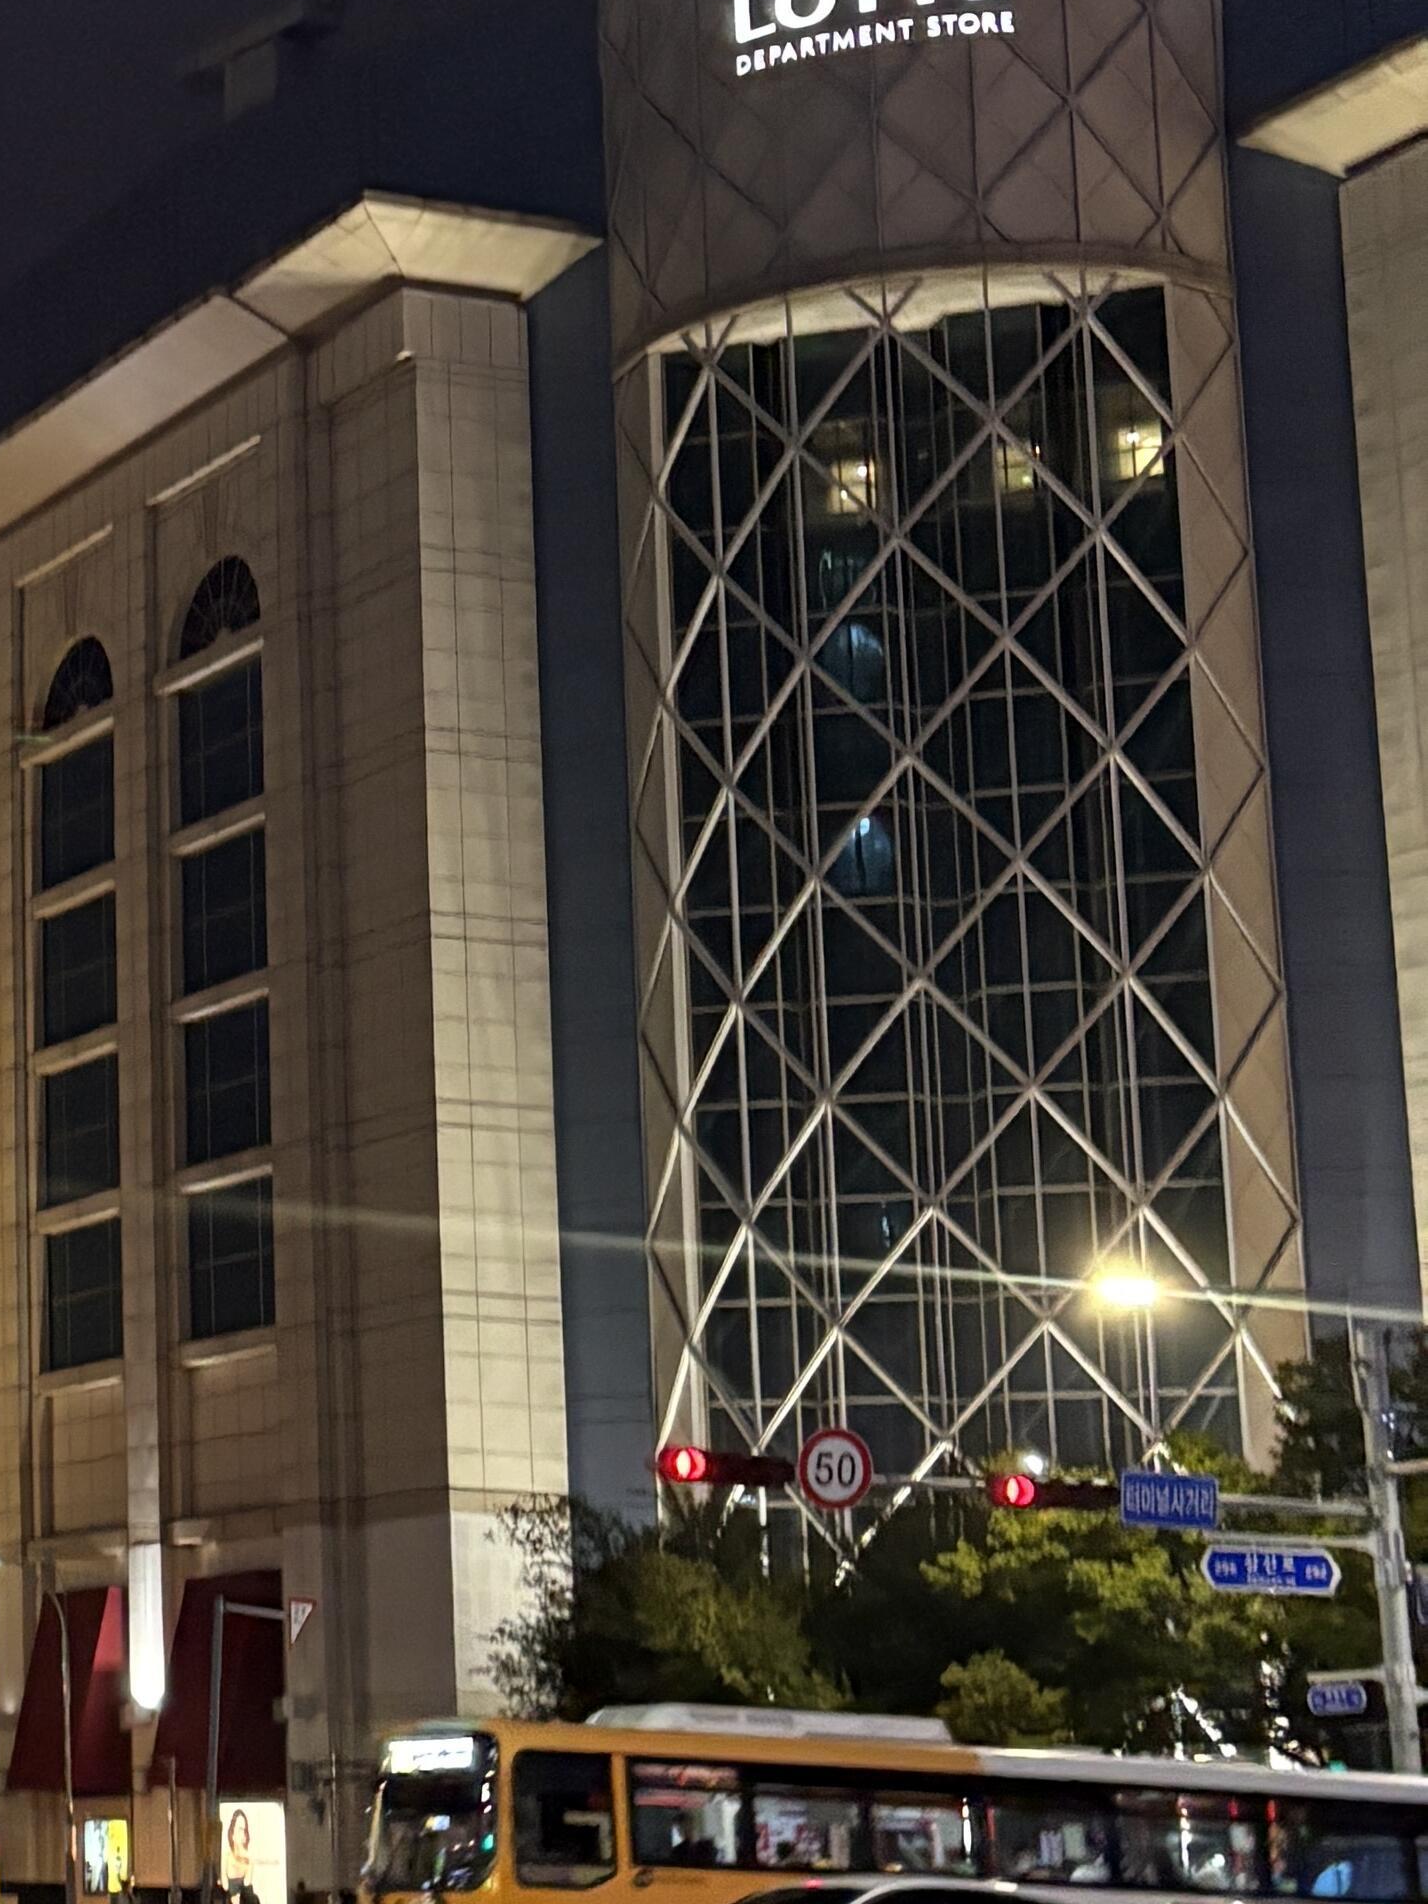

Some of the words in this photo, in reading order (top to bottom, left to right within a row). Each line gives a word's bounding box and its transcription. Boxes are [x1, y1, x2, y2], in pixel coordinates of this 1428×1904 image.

[736, 18, 913, 76] DEPARTMENT
[927, 11, 1014, 37] STORE
[815, 1452, 856, 1487] 50
